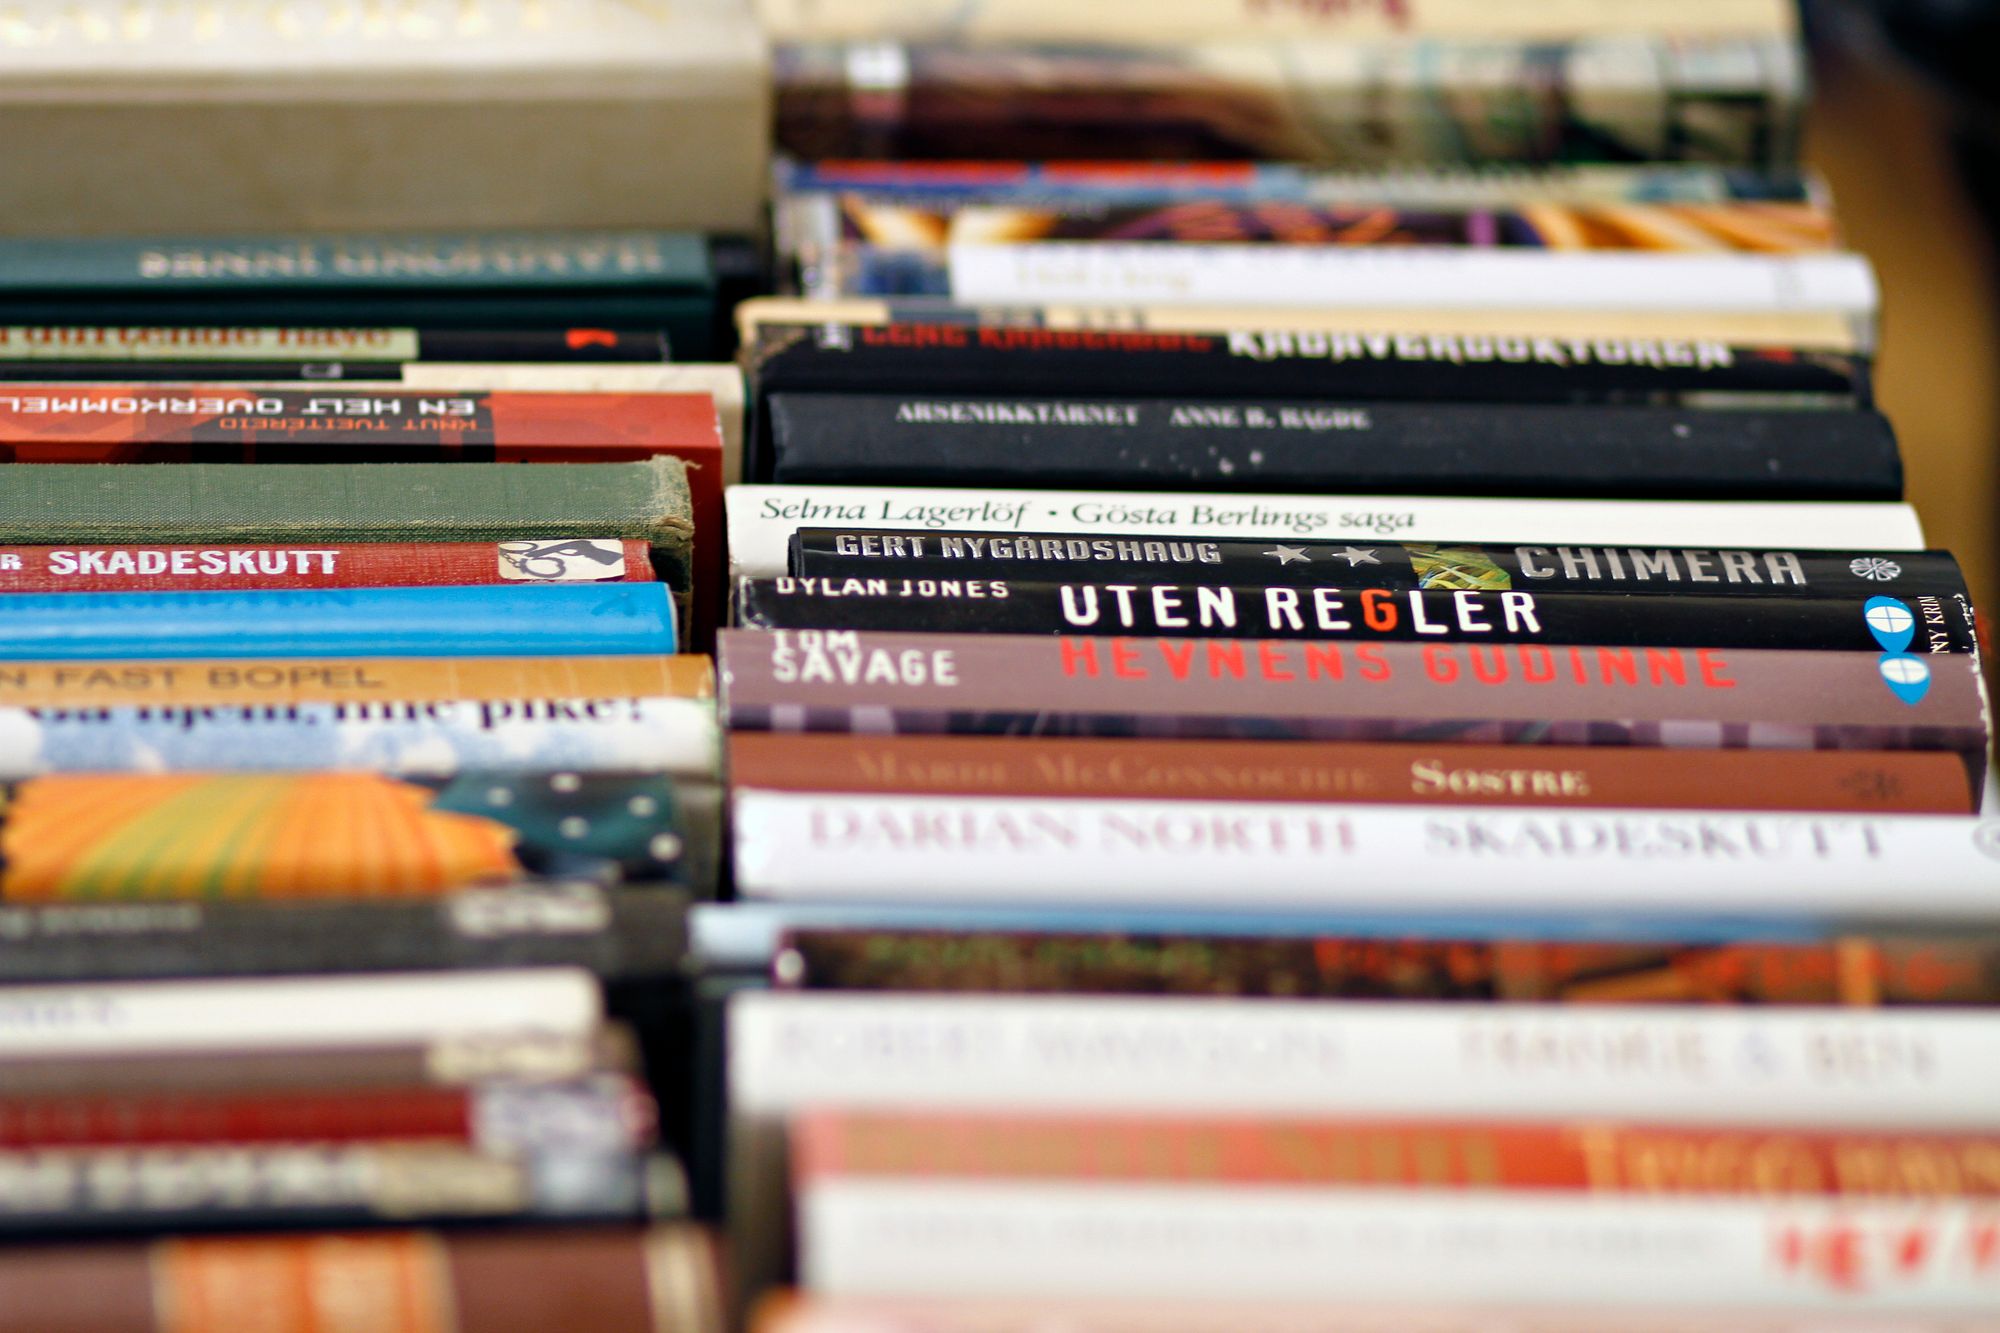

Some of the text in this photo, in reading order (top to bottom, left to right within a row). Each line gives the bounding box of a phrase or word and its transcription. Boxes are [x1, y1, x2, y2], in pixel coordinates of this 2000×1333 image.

[302, 398, 401, 415] HELT
[418, 398, 476, 415] EN
[1169, 404, 1241, 427] ANNE
[1280, 407, 1374, 431] RAGDE
[402, 417, 478, 432] KNUT
[760, 498, 1416, 536] Selma Lagerlöf Gösta Berlings saga
[48, 550, 341, 575] SKADESKUTT
[834, 534, 1809, 586] GERT NYGÅRDSHAUG CHIMERA
[775, 576, 1010, 599] DYLAN JONES
[1060, 584, 1542, 635] UTEN REGLER
[771, 628, 860, 651] TOM
[1929, 628, 1951, 654] NY
[771, 648, 959, 686] SAVAGE
[1060, 636, 1738, 690] HEVNENS GUDINNE
[54, 667, 182, 691] FAST
[207, 666, 384, 690] BOPEL
[808, 808, 1888, 862] DARIAN NORTH SKADESKUTT
